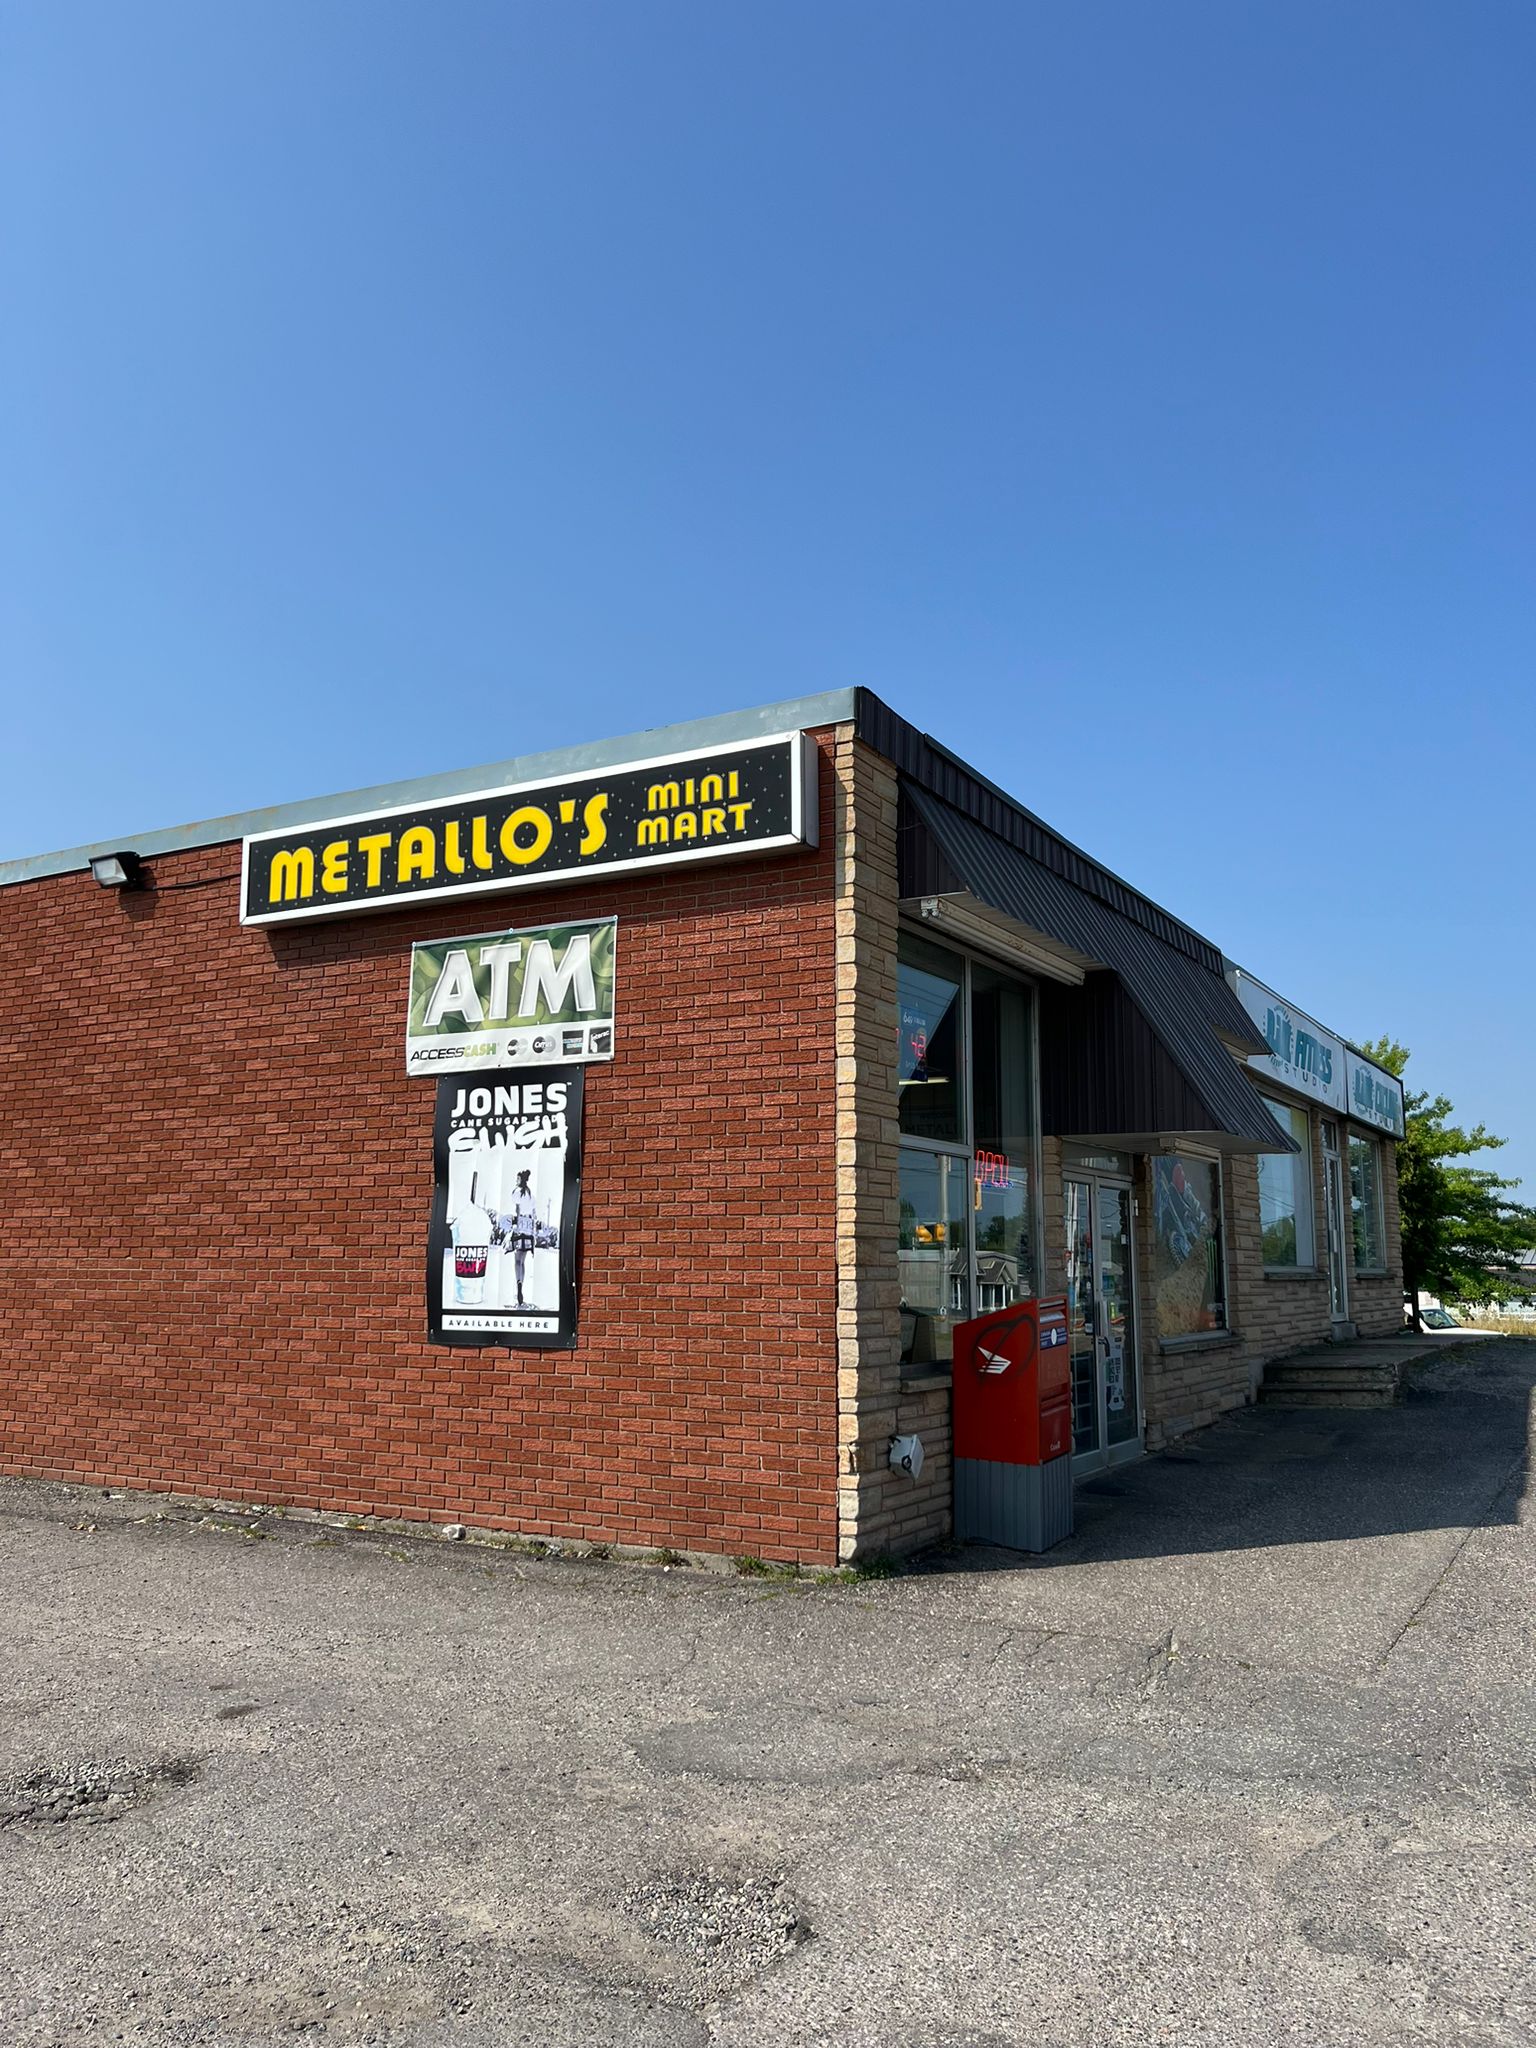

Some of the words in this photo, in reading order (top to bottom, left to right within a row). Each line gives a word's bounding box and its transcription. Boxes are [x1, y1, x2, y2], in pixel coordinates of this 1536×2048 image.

[647, 769, 739, 812] MINI
[637, 801, 753, 846] MART
[268, 792, 609, 904] METALLO'S
[422, 933, 597, 1027] ATM
[450, 1082, 568, 1118] JONES
[450, 1118, 482, 1128] CANE
[488, 1116, 528, 1126] SUGAR
[455, 1247, 488, 1258] JONES
[448, 1319, 514, 1328] AVAILABLE
[519, 1320, 550, 1329] HERE
